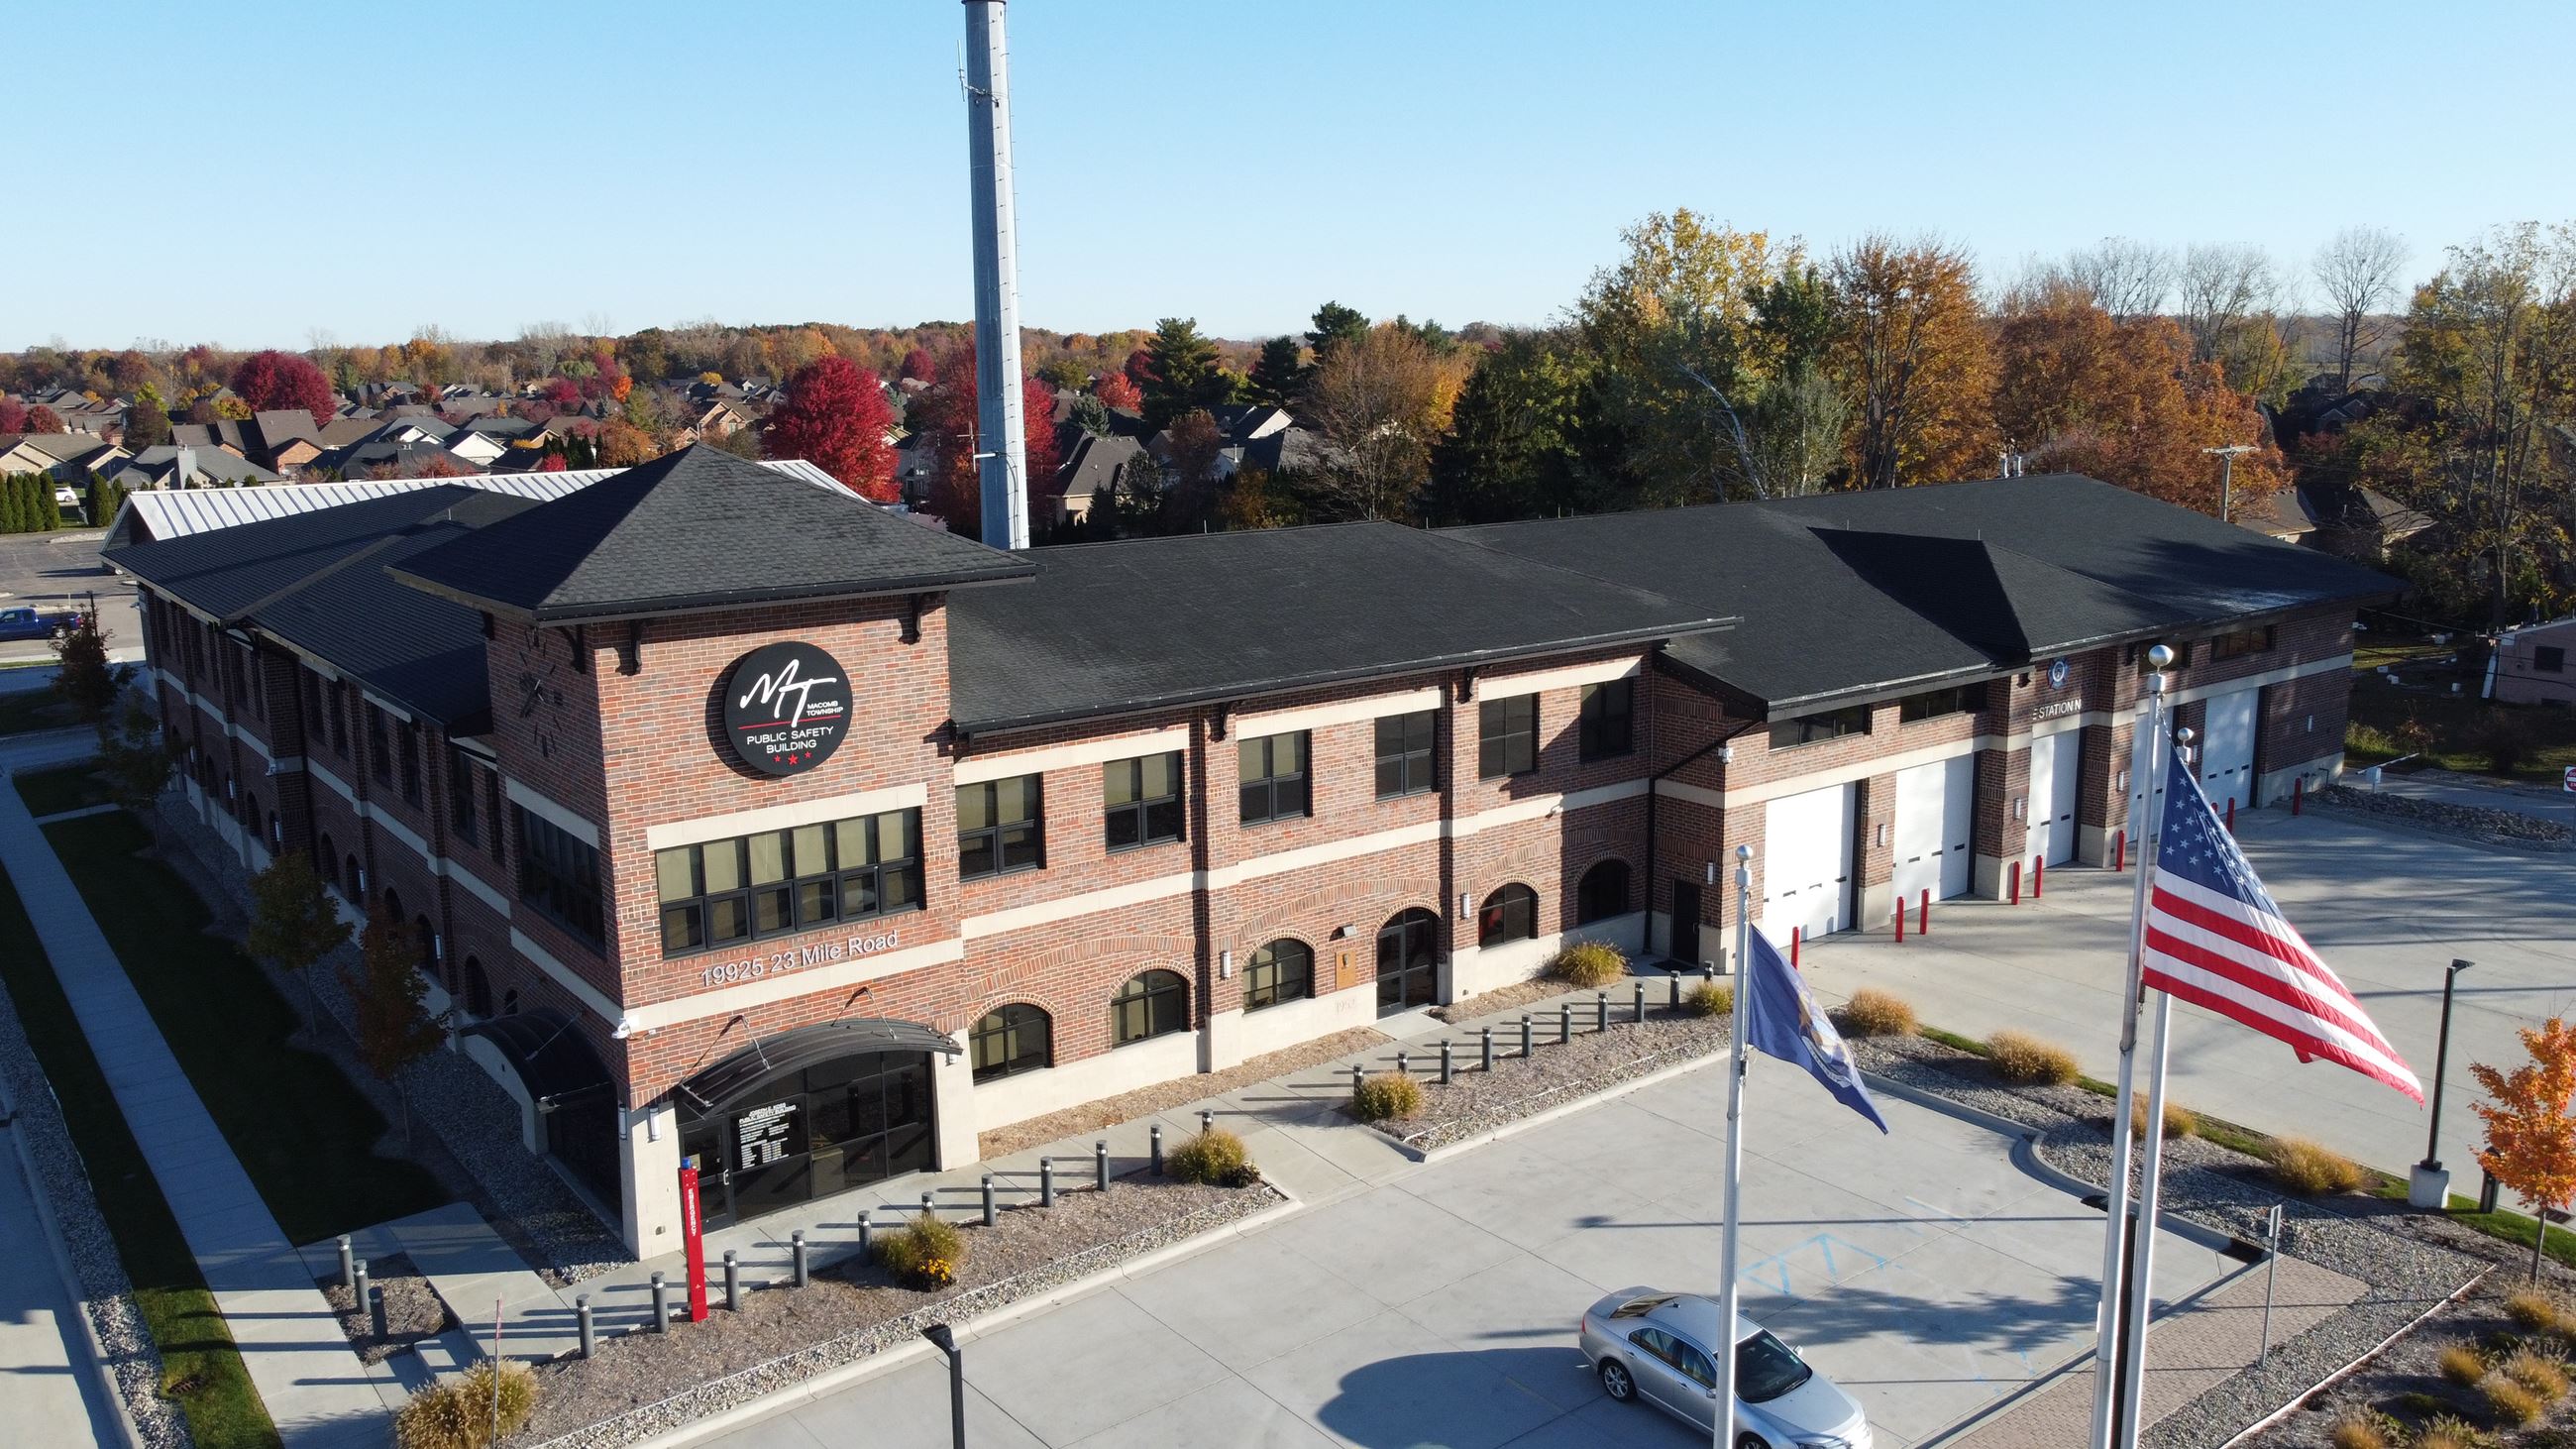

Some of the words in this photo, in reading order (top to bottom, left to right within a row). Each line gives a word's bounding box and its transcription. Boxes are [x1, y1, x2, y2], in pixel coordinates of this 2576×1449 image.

[806, 700, 838, 709] MACOMB
[806, 706, 844, 717] TOWNSHIP
[2039, 701, 2074, 718] STATION
[746, 731, 787, 745] PUBLIC
[791, 725, 834, 740] SAFETY
[766, 739, 817, 753] BUILDING
[700, 958, 764, 986] 19925
[770, 951, 796, 973] 23
[801, 943, 841, 967] Mile
[848, 929, 899, 957] Road
